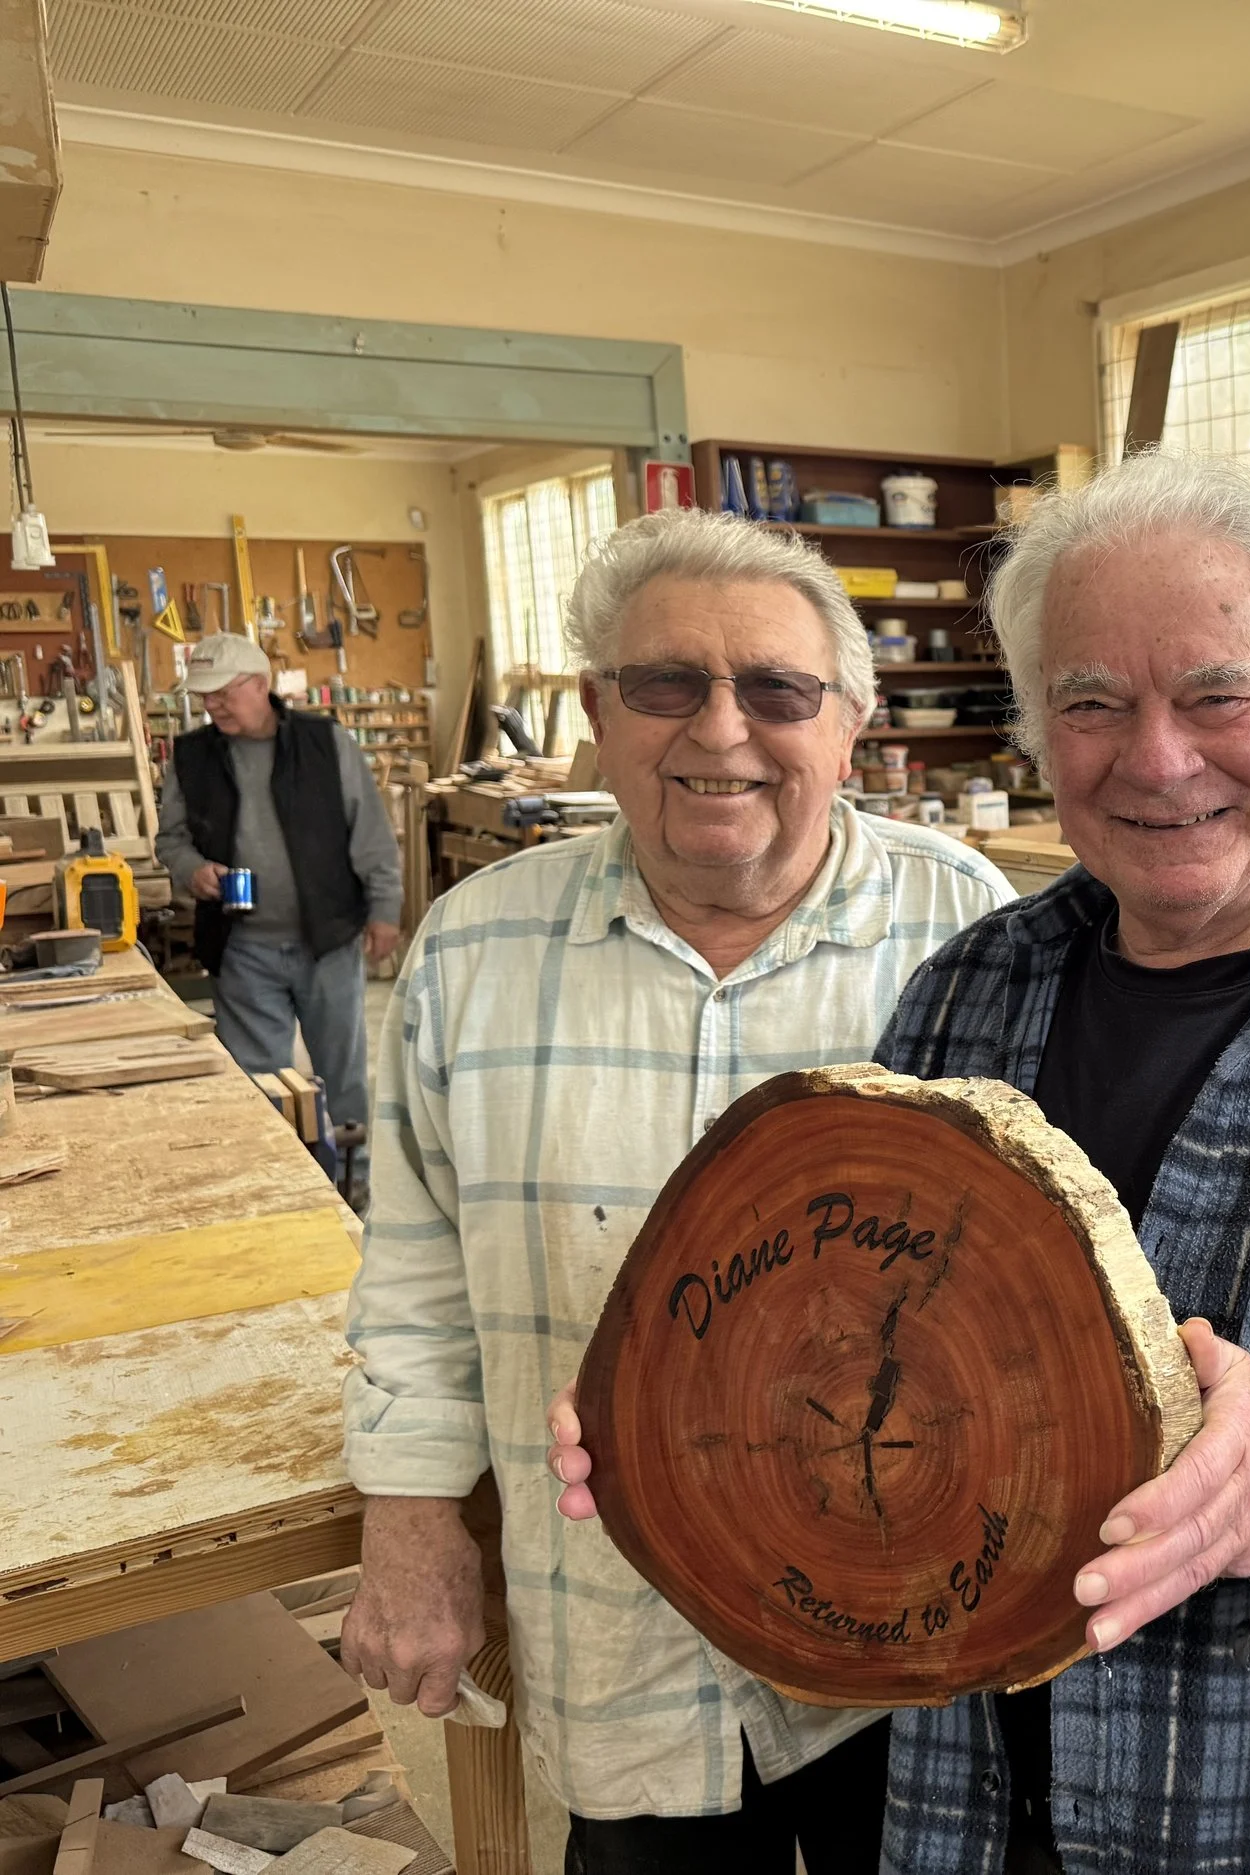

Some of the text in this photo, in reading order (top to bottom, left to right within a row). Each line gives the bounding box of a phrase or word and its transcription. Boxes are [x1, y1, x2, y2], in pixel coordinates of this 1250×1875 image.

[667, 1192, 936, 1341] Diane Page
[772, 1502, 1009, 1643] Returned to Earth
